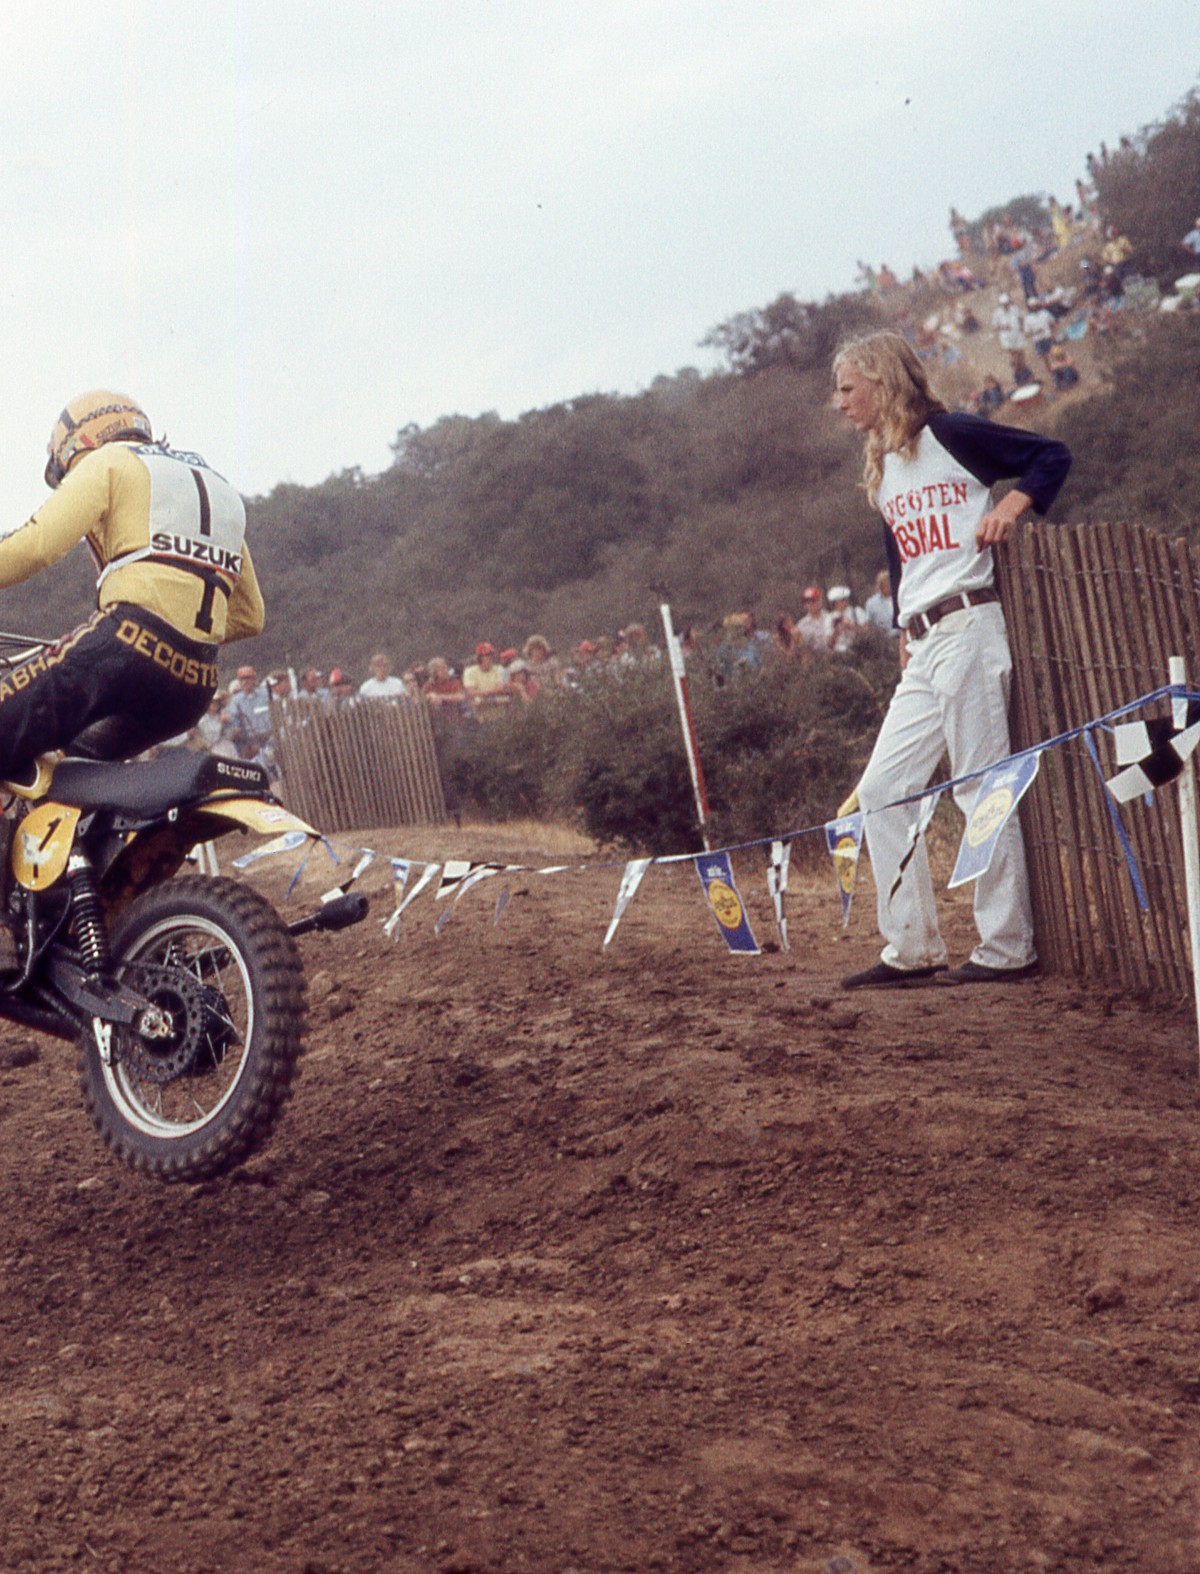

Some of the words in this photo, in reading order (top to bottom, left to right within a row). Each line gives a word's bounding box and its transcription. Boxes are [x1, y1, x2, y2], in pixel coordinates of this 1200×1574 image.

[190, 467, 211, 538] 1
[922, 482, 968, 509] TEN
[151, 532, 242, 574] SUZUK
[0, 656, 47, 701] ABH
[217, 762, 261, 781] SUZUKI
